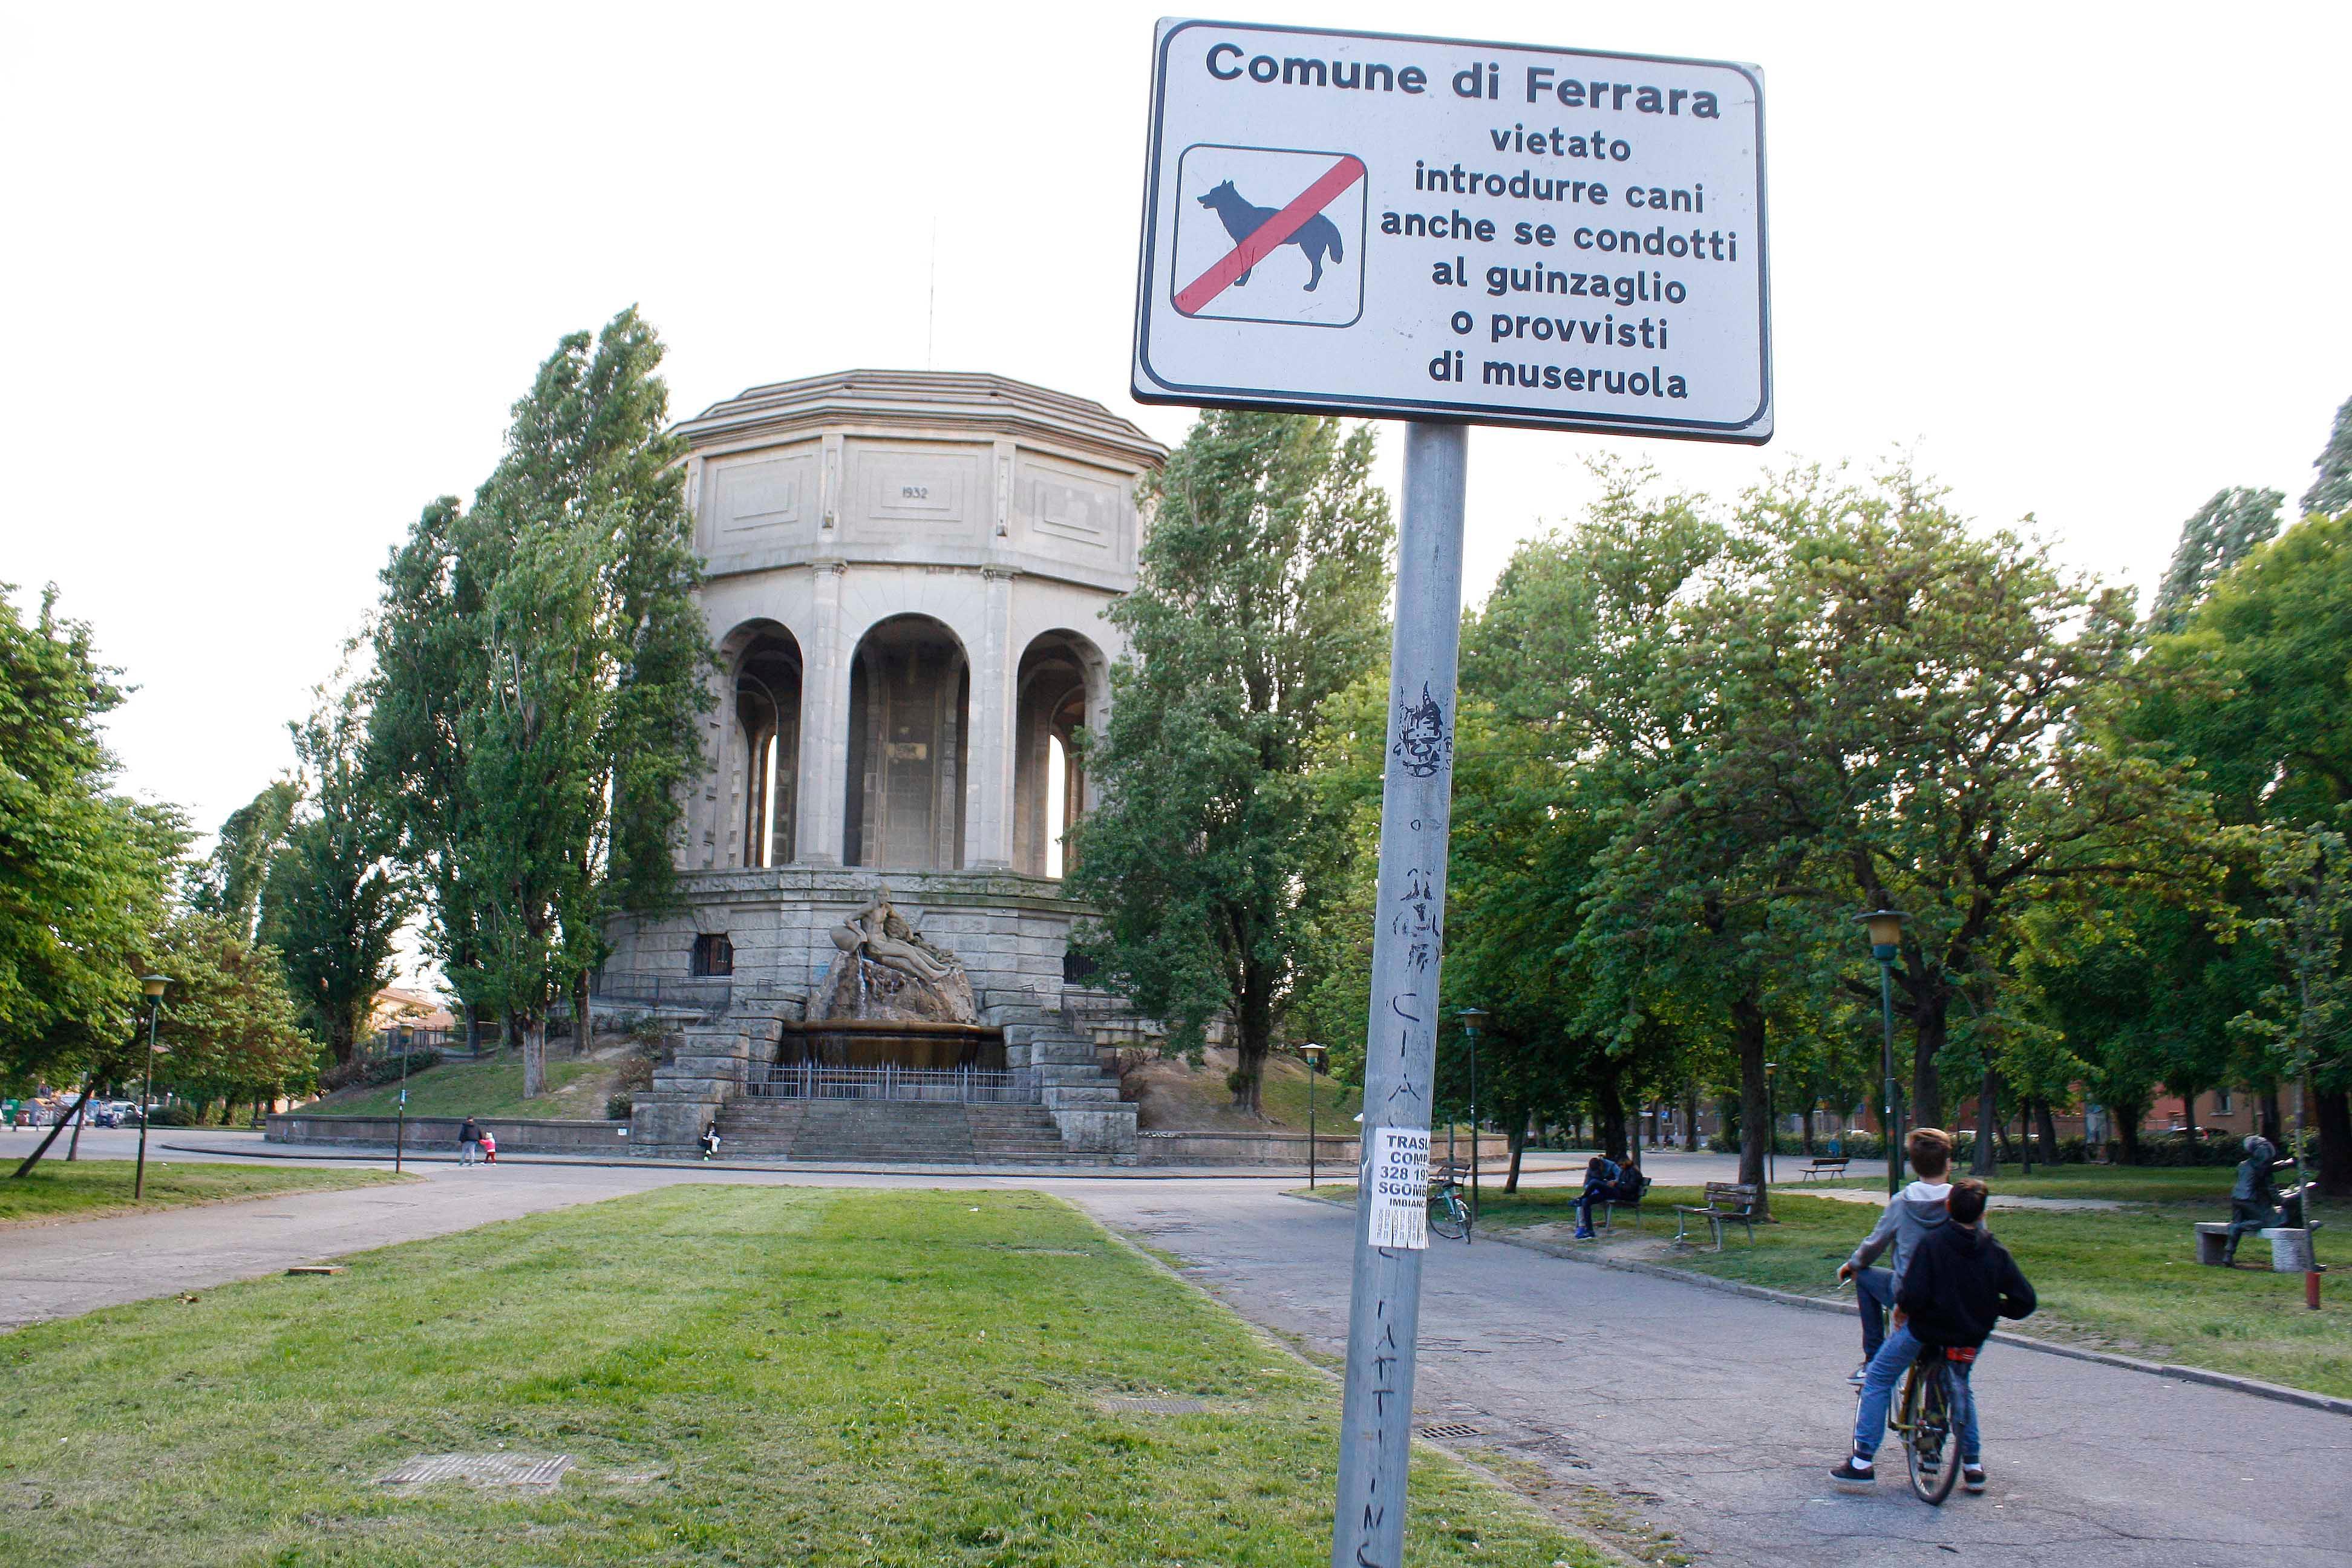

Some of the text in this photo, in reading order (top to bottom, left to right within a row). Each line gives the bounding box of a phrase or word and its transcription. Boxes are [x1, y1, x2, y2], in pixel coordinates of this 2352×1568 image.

[1206, 42, 1720, 120] Comune di Ferrara
[1490, 124, 1631, 162] vietato
[1416, 160, 1703, 214] introdurre cani
[1380, 209, 1736, 262] anche se condotti
[1432, 256, 1687, 307] al guinzaglio
[1451, 310, 1667, 350] o provvisti
[1428, 350, 1688, 399] di museruola
[900, 486, 928, 499] 1932
[1386, 1134, 1431, 1151] TRASL
[1390, 1151, 1430, 1166] COMP
[1380, 1166, 1408, 1180] 328
